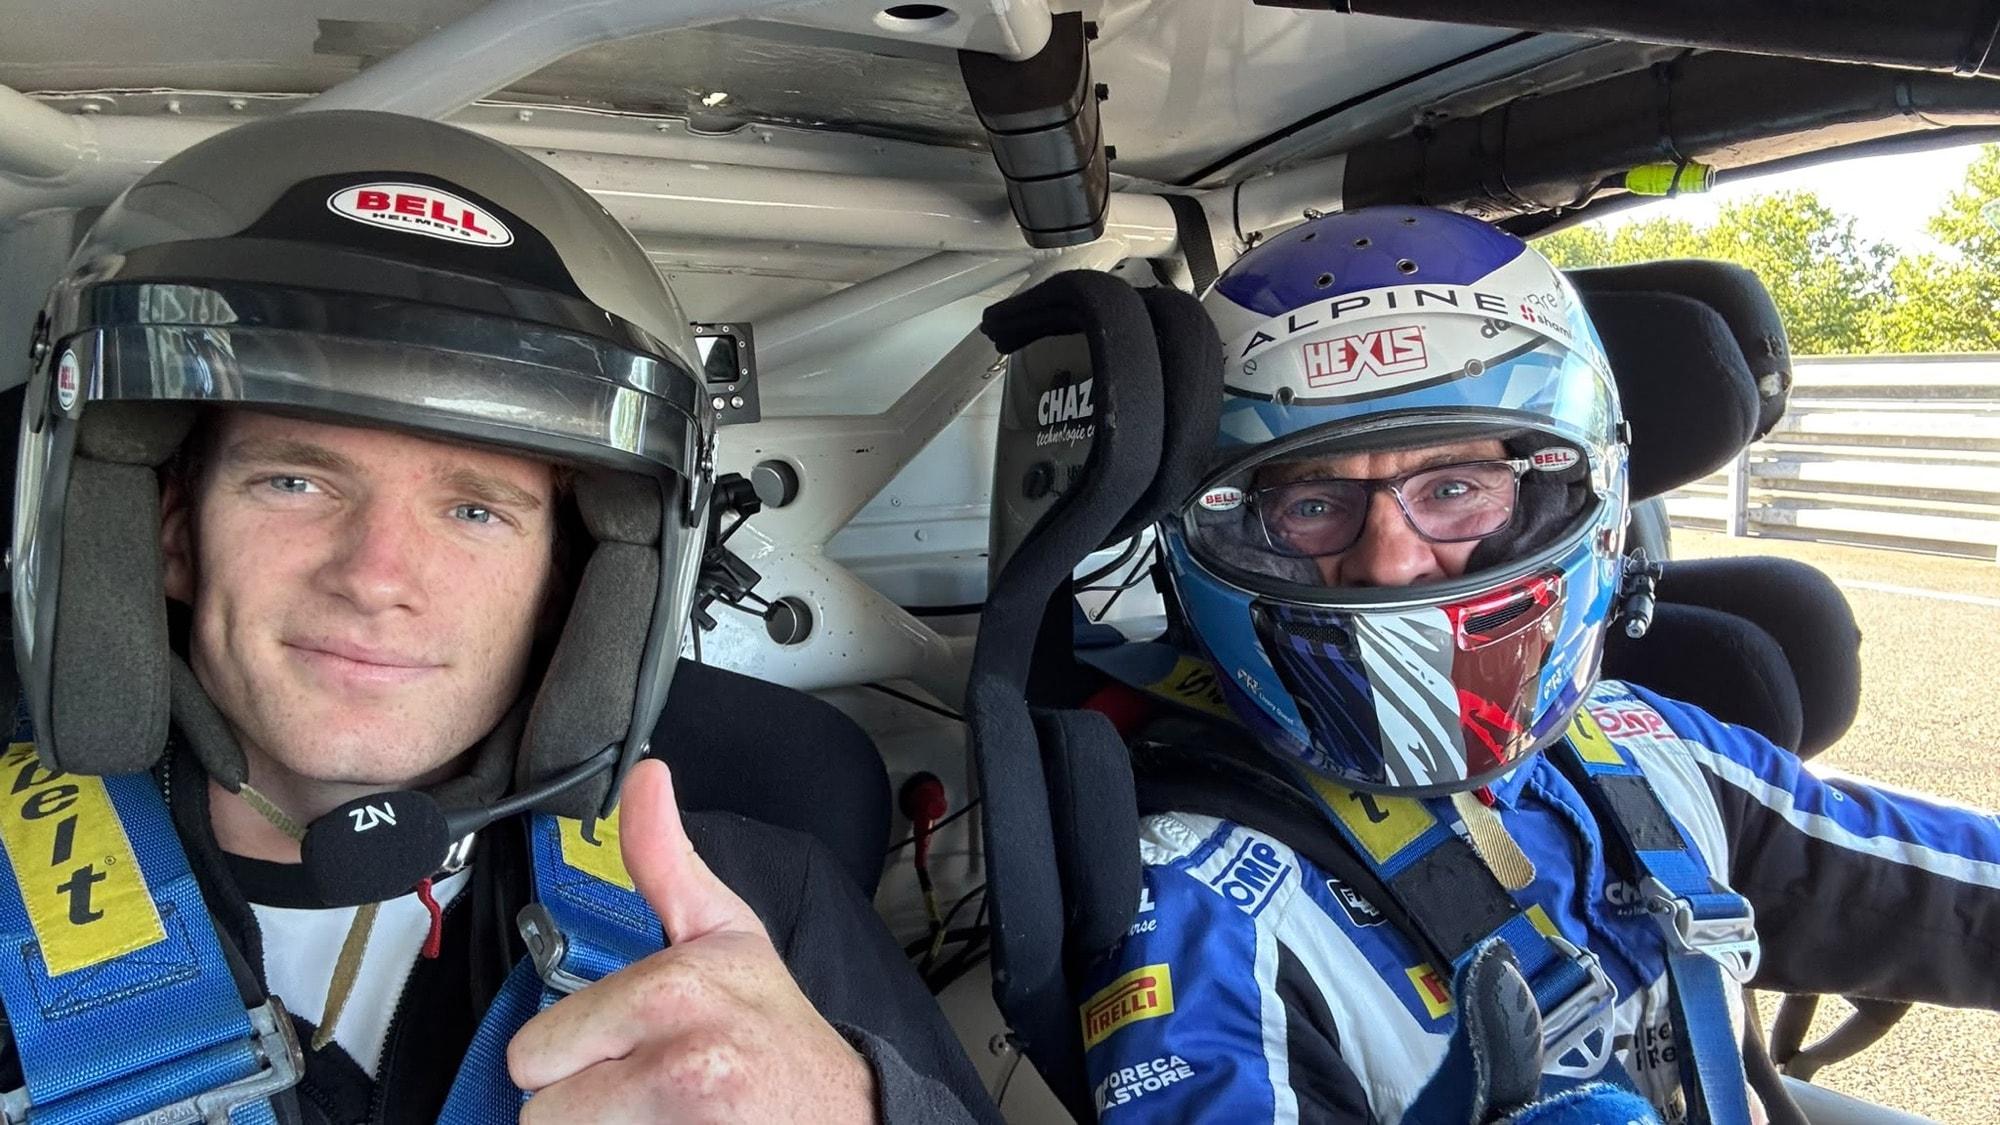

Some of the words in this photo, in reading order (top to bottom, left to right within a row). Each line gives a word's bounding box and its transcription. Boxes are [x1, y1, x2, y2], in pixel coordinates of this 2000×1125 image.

[356, 190, 488, 236] BELL
[372, 213, 471, 237] HELMETS
[1240, 289, 1509, 358] ALPINE
[1303, 325, 1428, 388] HEXIS
[1038, 377, 1094, 426] CHAZ
[1535, 453, 1569, 465] BELL
[1205, 492, 1238, 504] BELL
[1222, 842, 1282, 907] OMP
[1087, 976, 1158, 1040] PIRELLI
[1113, 1065, 1195, 1105] STORE
